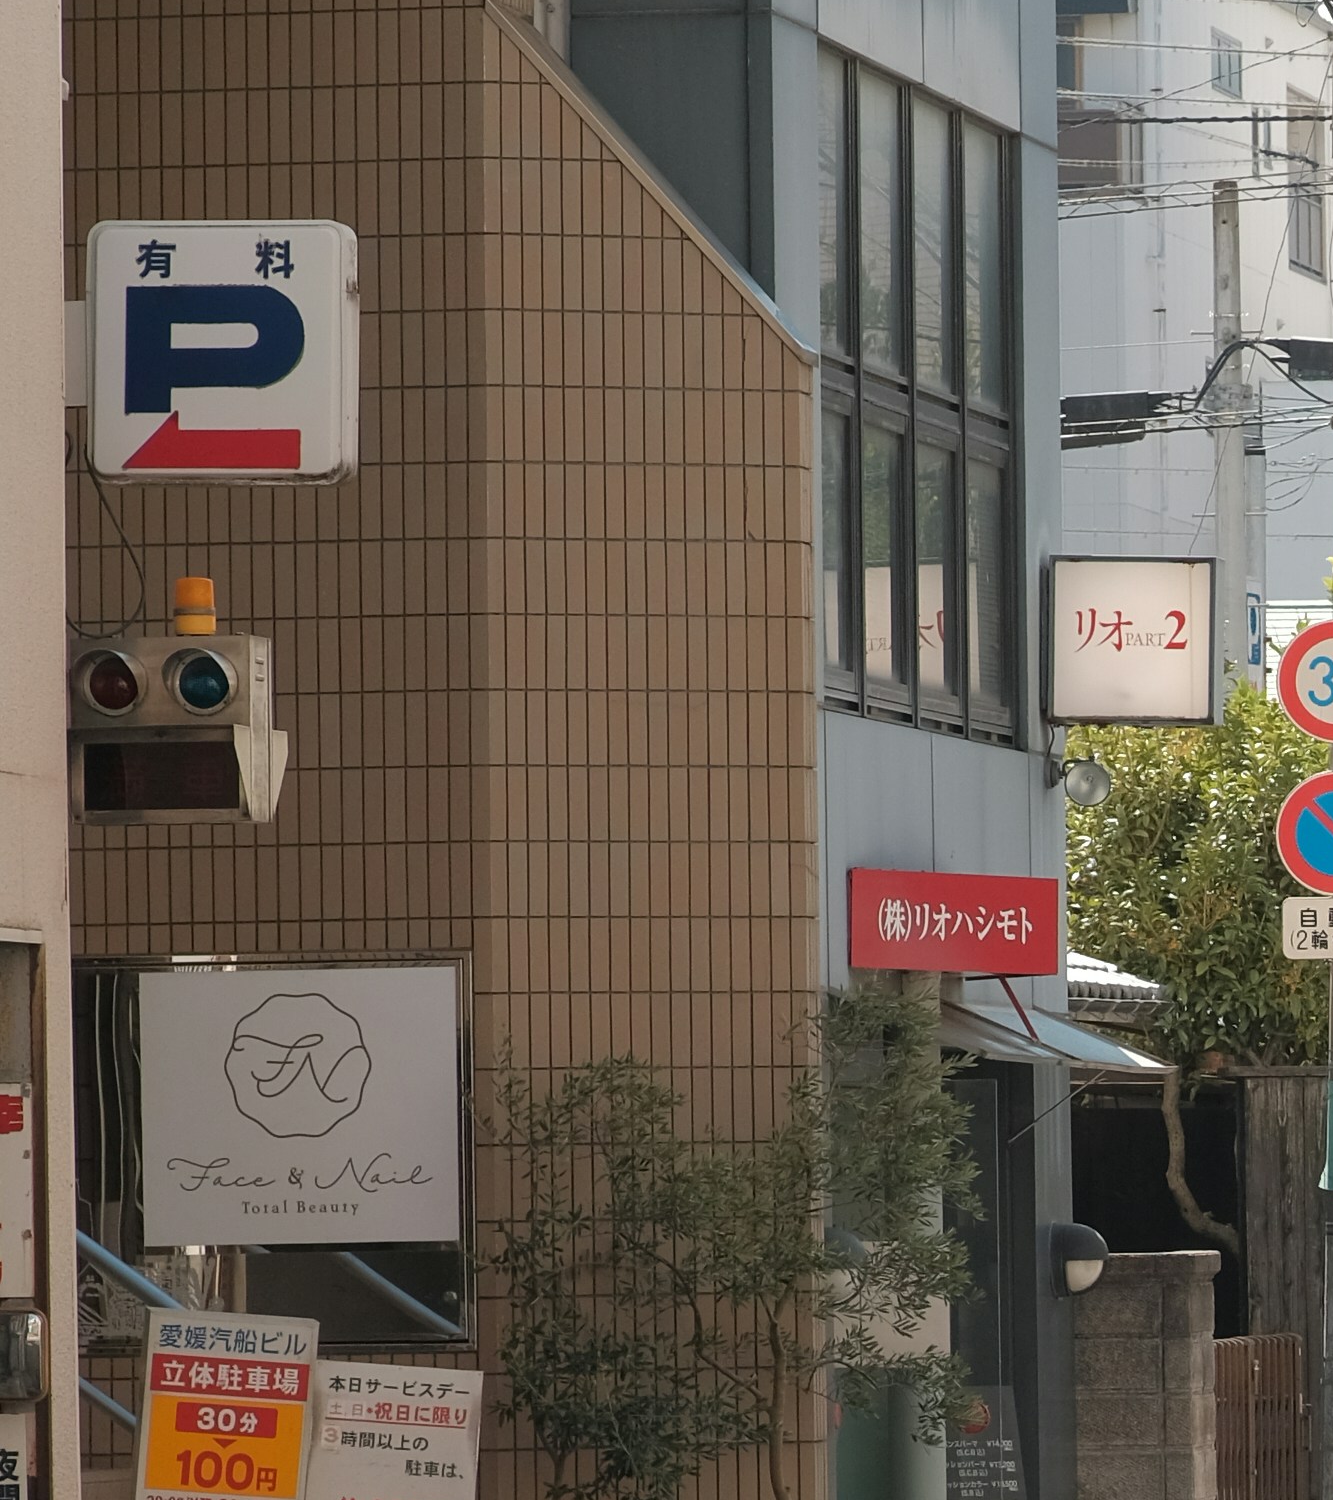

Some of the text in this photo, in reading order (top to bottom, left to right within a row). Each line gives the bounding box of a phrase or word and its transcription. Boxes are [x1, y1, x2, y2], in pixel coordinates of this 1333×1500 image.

[136, 239, 294, 279] 有料
[125, 286, 305, 415] P
[878, 898, 1033, 945] (株)リオハシモト
[166, 1153, 433, 1192] Face & Nail
[242, 1200, 359, 1215] Total Beauty
[159, 1324, 307, 1356] 愛媛汽船ビル
[160, 1359, 300, 1395] 立体駐車場
[329, 1375, 470, 1400] 本日サービスデー
[196, 1407, 258, 1433] 30分
[323, 1427, 429, 1451] 3時間以上の
[176, 1449, 278, 1492] 100円
[405, 1460, 464, 1479] 駐車は、
